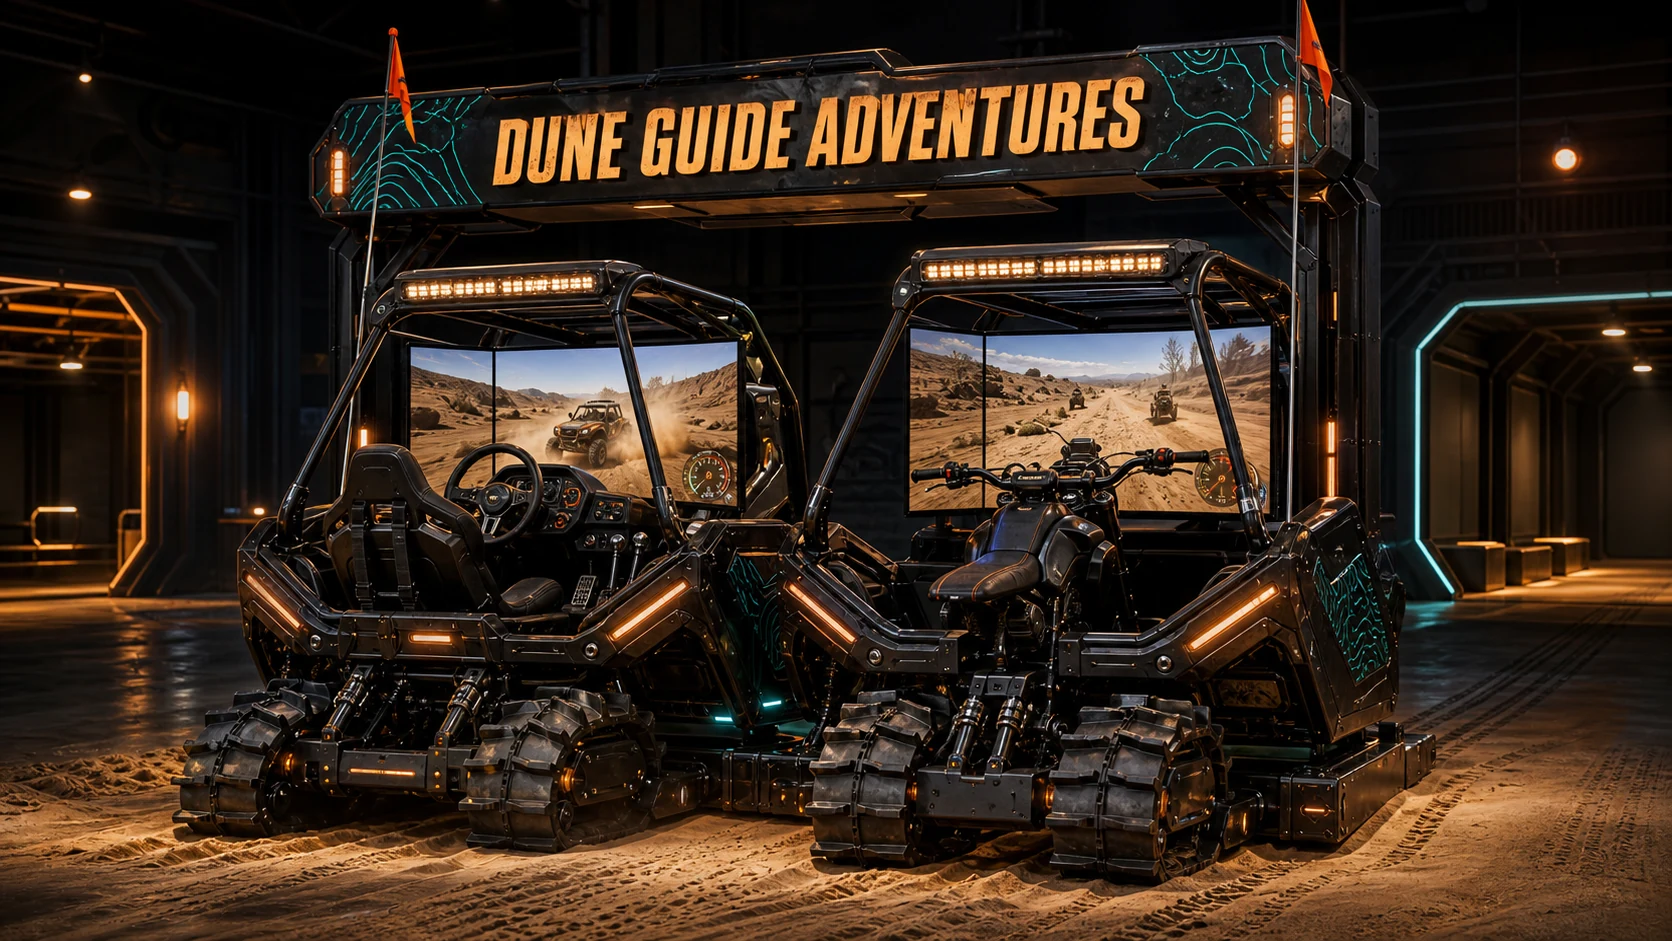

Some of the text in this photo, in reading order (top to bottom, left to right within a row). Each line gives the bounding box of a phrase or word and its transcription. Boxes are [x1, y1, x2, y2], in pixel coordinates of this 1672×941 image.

[492, 76, 1146, 186] DUNE GUIDE ADVENTURES
